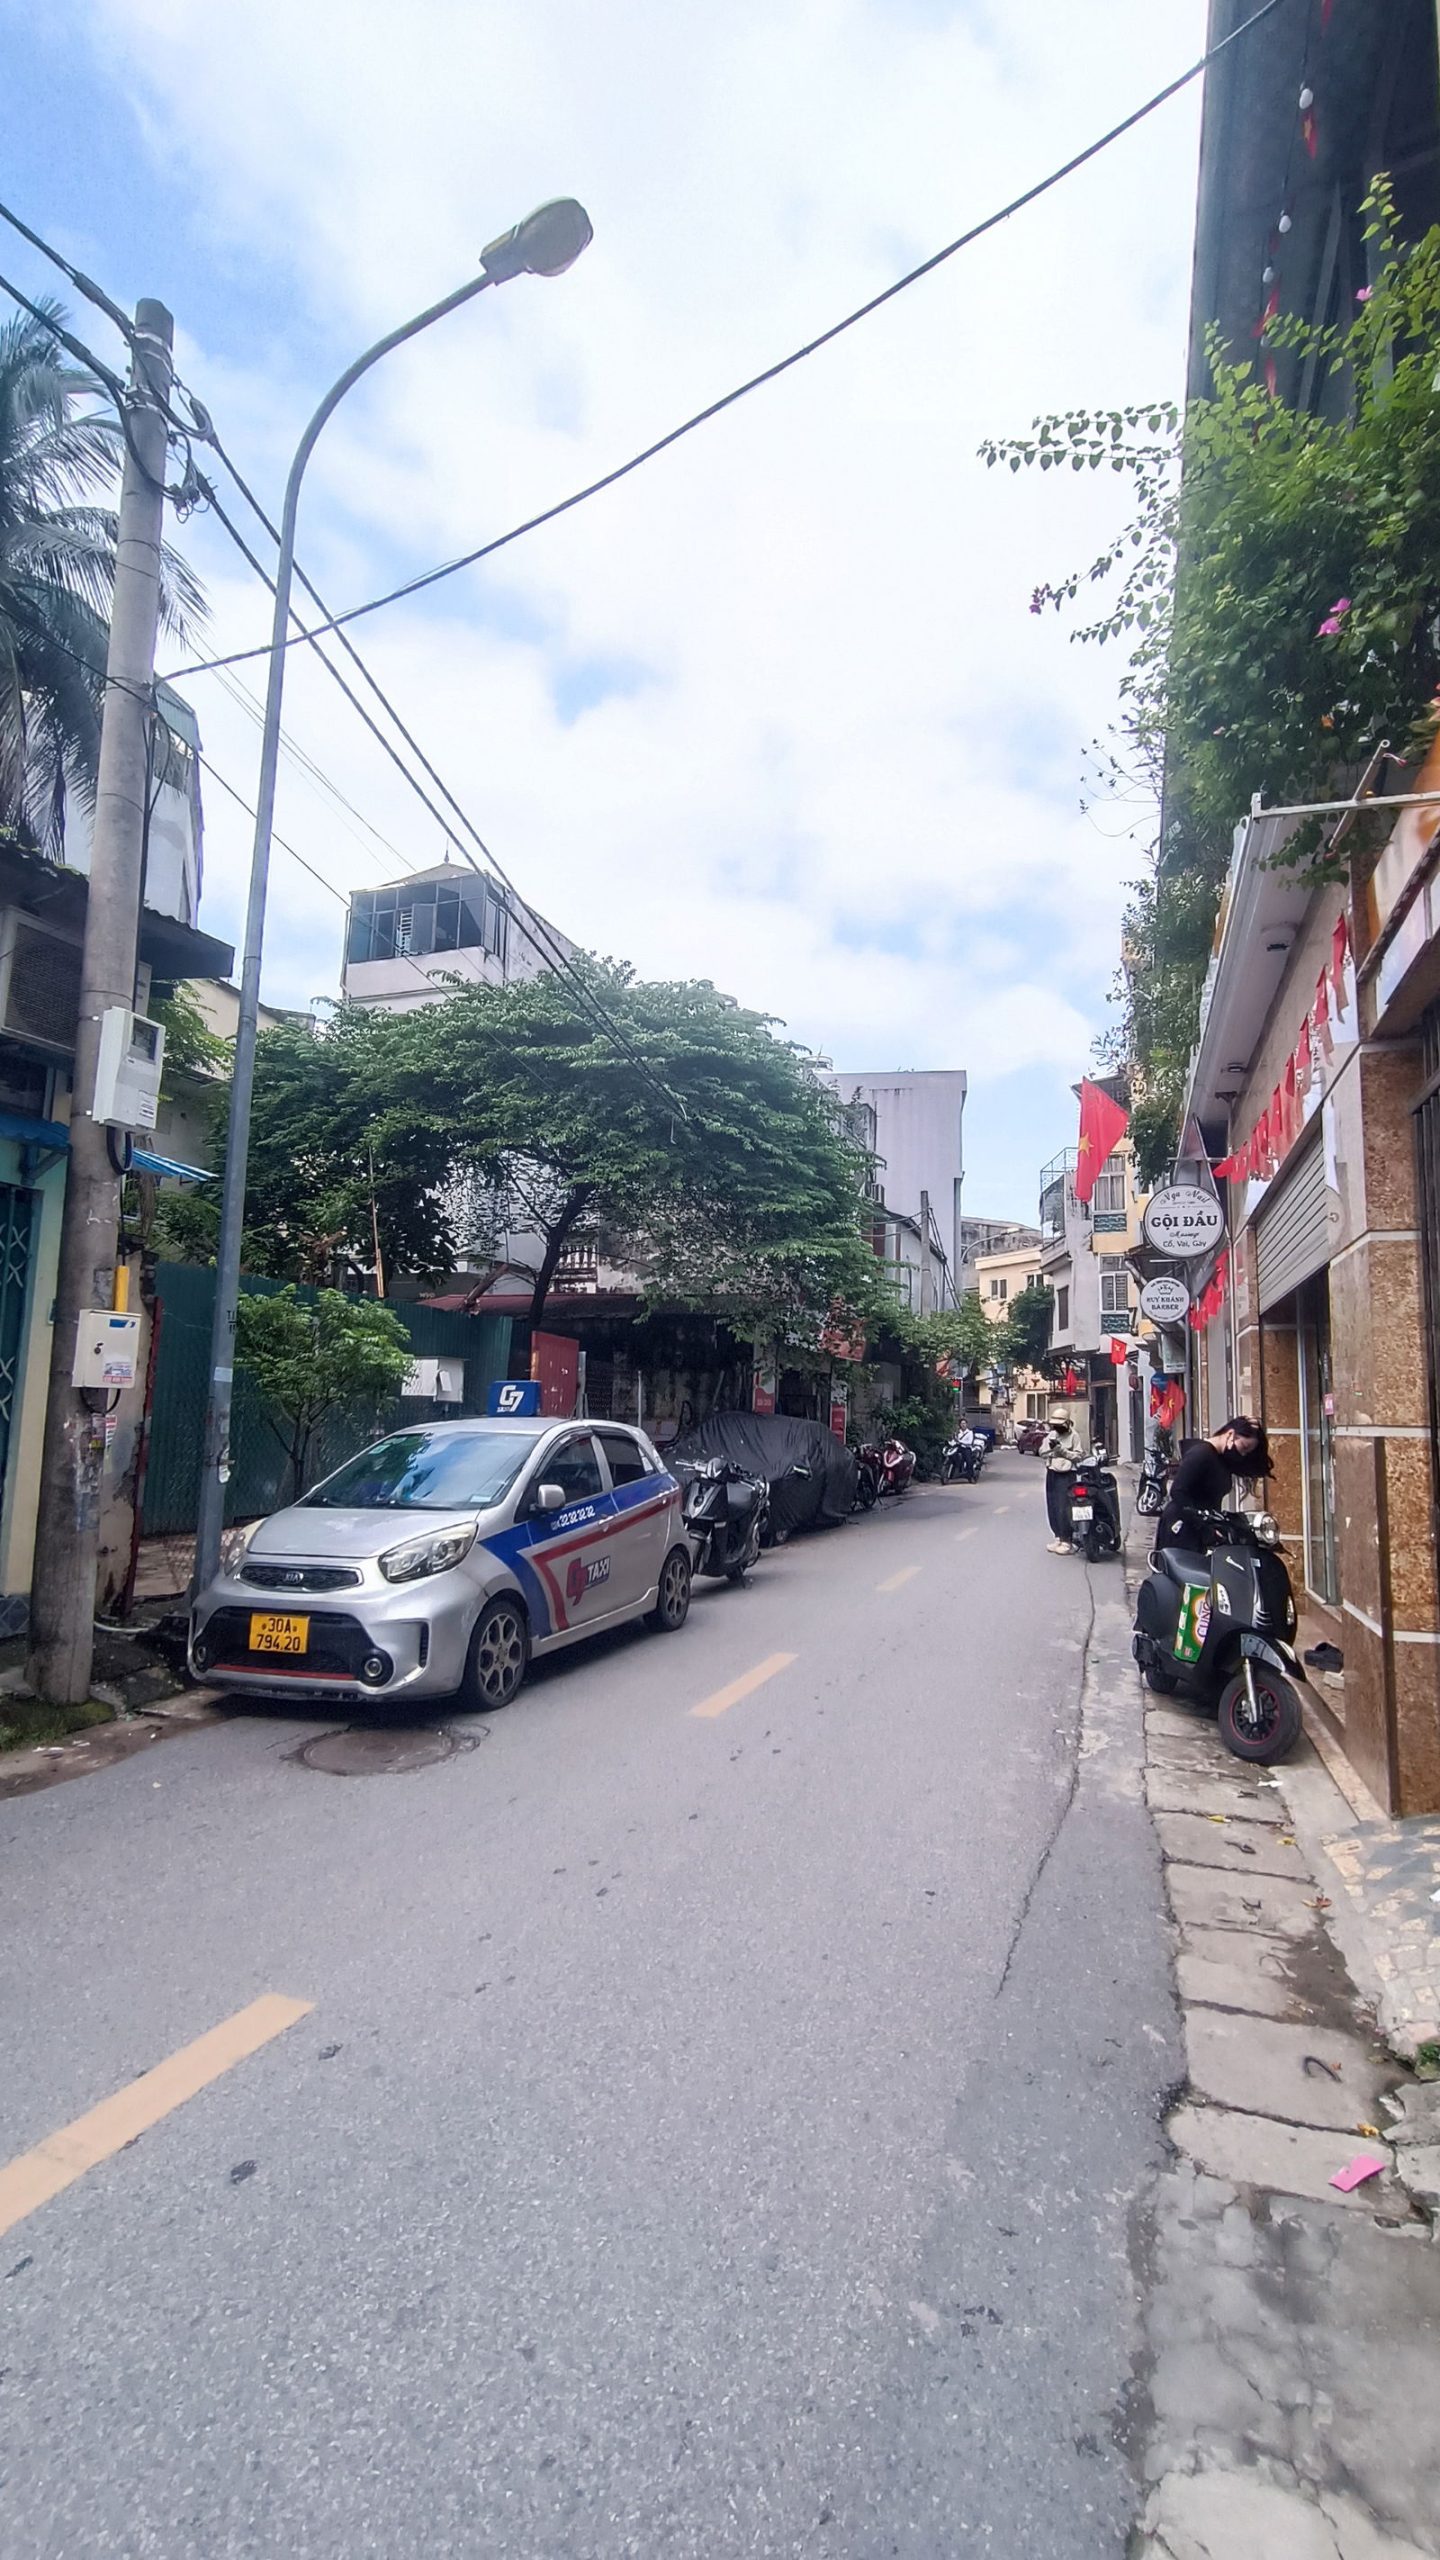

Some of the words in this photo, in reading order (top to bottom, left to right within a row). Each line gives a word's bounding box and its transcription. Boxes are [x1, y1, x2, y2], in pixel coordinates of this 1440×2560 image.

[1151, 1213, 1179, 1231] GỘI
[1183, 1210, 1218, 1227] ĐẦU
[500, 1384, 525, 1412] G7
[587, 1557, 611, 1581] TAXI
[268, 1617, 292, 1634] 30A
[256, 1633, 301, 1652] 794.20
